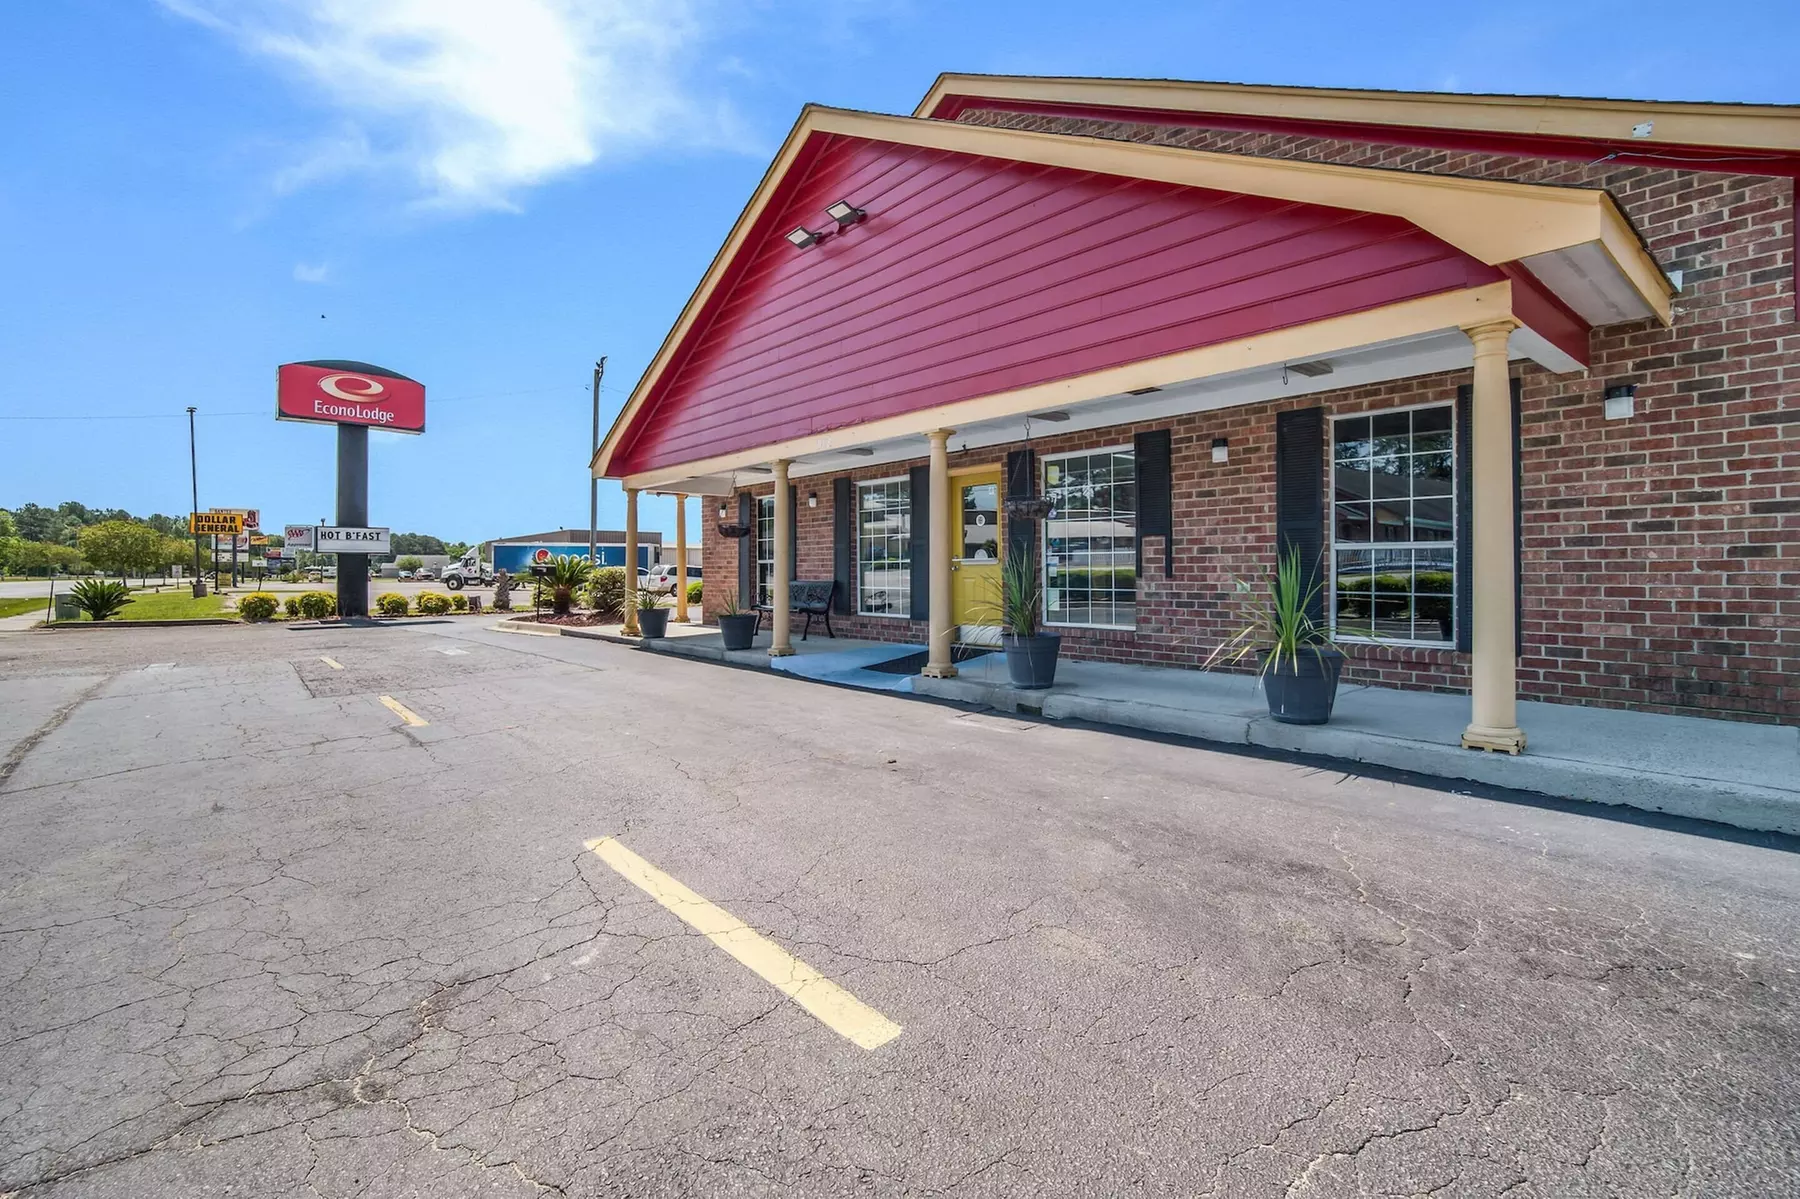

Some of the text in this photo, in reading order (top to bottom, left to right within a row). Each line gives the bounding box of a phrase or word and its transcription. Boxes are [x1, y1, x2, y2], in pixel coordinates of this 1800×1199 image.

[314, 400, 394, 424] EconoLodge
[197, 515, 236, 524] DOLLAR
[320, 531, 341, 540] HOT
